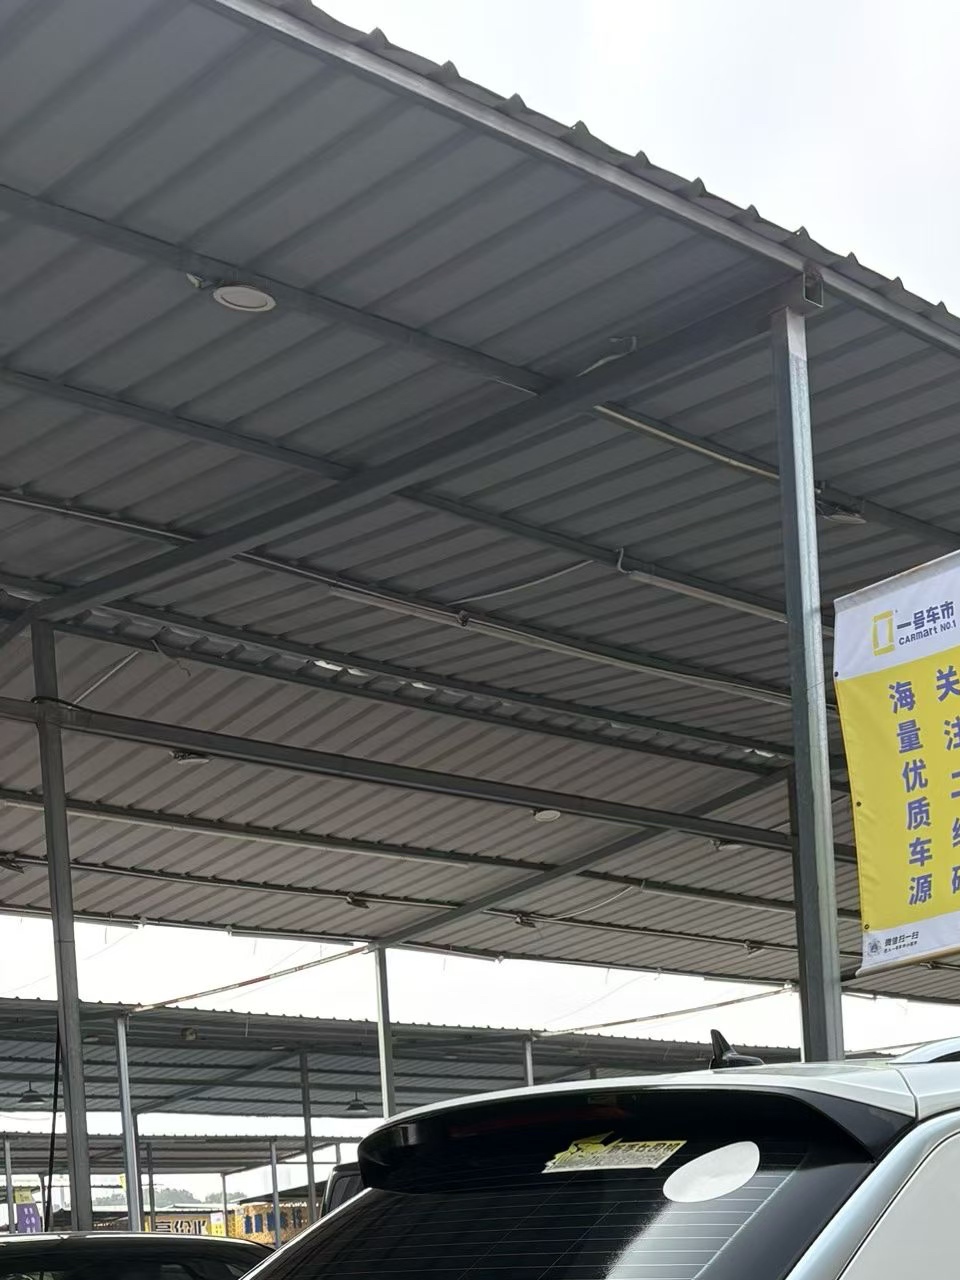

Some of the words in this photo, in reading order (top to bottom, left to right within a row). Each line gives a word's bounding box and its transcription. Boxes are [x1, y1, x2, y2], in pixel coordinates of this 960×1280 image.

[897, 601, 954, 630] 一号车市
[898, 625, 938, 645] CARmart
[940, 619, 957, 632] NO.1
[888, 680, 933, 906] 海量优质车源
